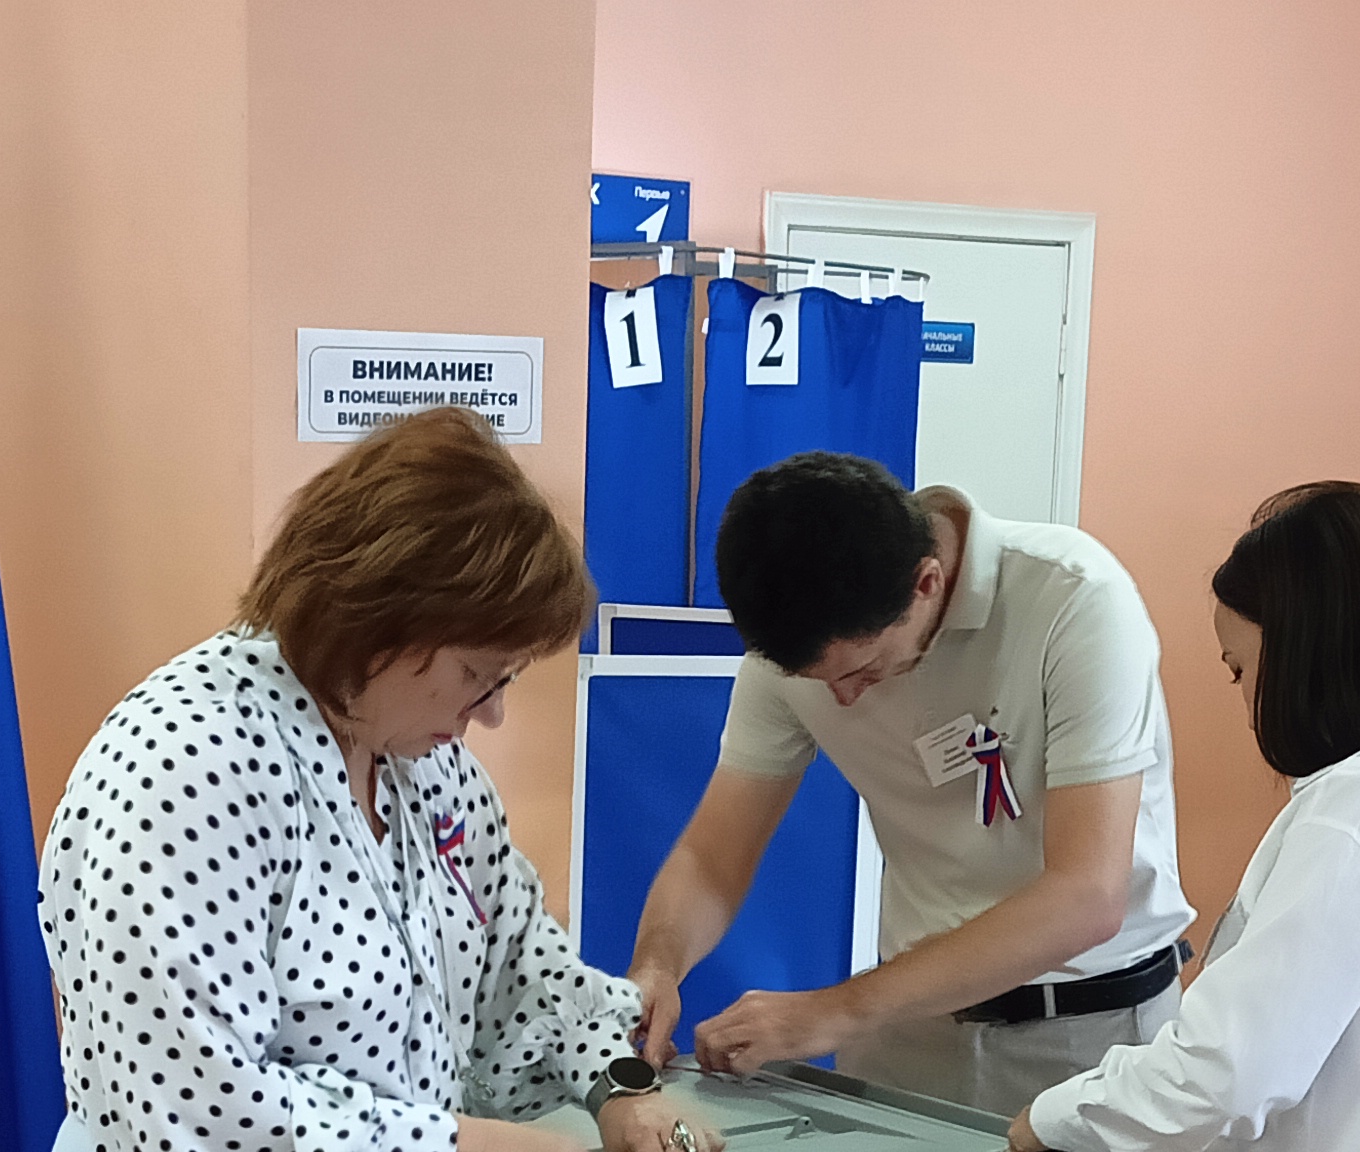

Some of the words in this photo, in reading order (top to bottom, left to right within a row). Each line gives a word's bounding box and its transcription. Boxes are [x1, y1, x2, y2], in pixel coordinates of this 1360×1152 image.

[619, 310, 646, 369] 1
[757, 313, 785, 368] 2
[922, 332, 963, 342] АЧАЛЬНЫЕ
[352, 360, 494, 382] ВНИМАНИЕ!
[324, 390, 334, 404] В
[339, 390, 445, 406] ПОМЕЩЕНИИ
[449, 388, 518, 407] ВЕДЁТСЯ
